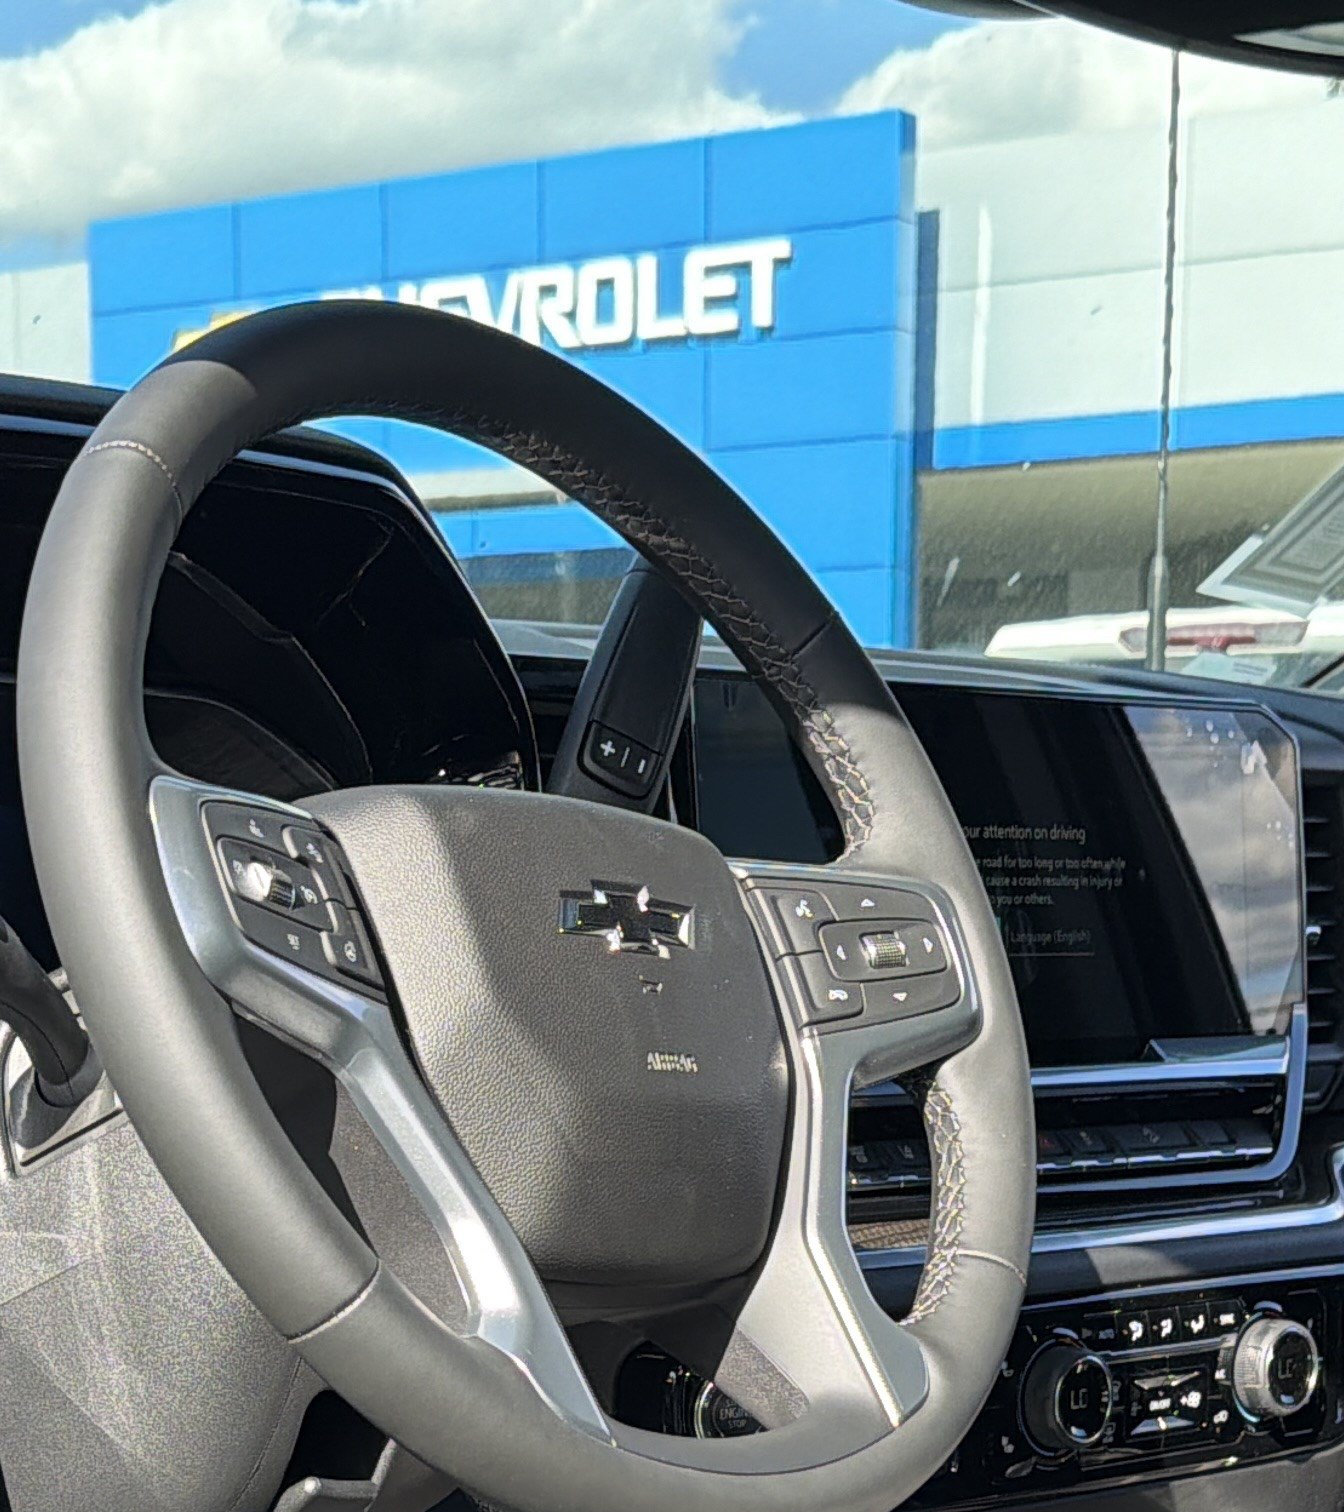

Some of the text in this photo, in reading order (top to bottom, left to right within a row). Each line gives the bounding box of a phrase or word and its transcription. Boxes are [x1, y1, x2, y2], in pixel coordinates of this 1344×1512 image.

[318, 236, 793, 348] VROLET
[962, 824, 1086, 844] our attention on driving
